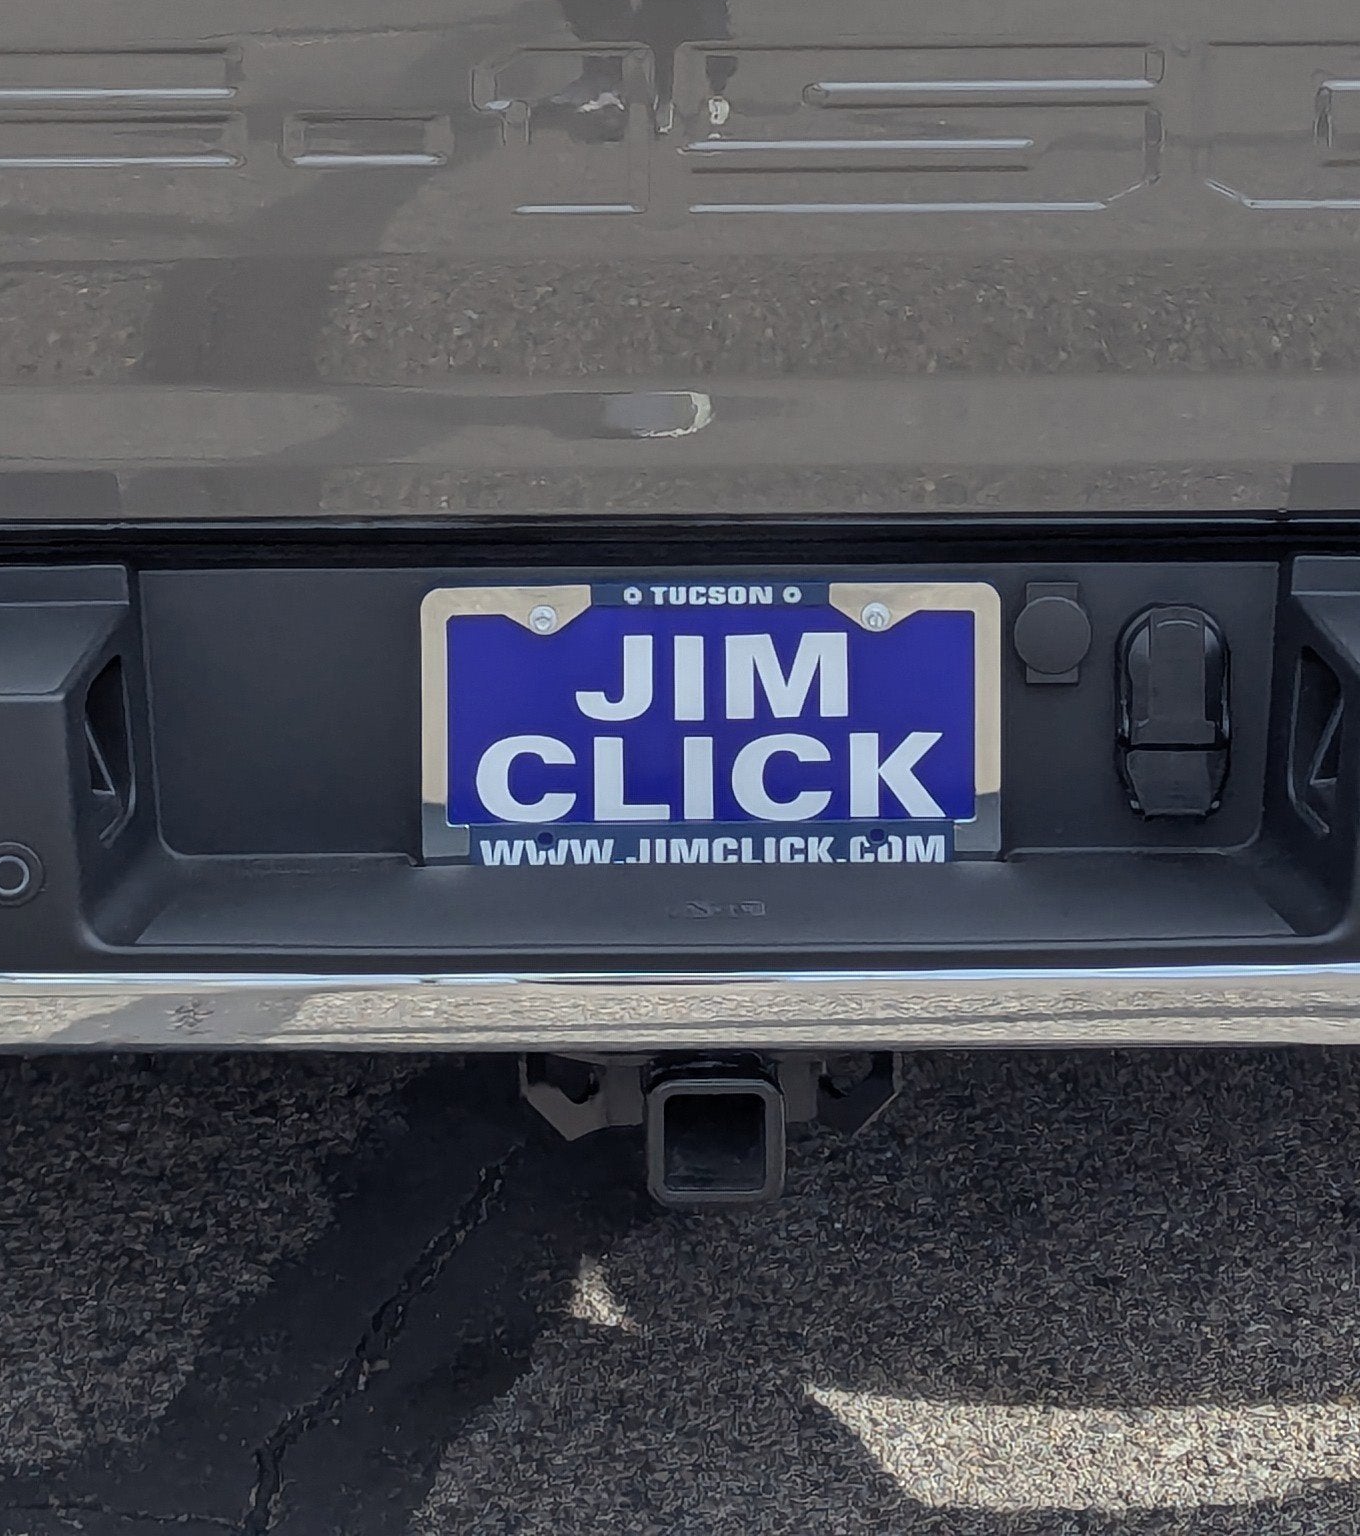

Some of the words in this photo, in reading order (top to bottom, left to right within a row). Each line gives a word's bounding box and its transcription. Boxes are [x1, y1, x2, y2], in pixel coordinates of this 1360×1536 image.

[649, 585, 774, 606] TUCSON
[575, 631, 849, 722] JIM
[475, 730, 947, 822] CLICK
[478, 834, 946, 865] WWW.JIMCLICK.COM
